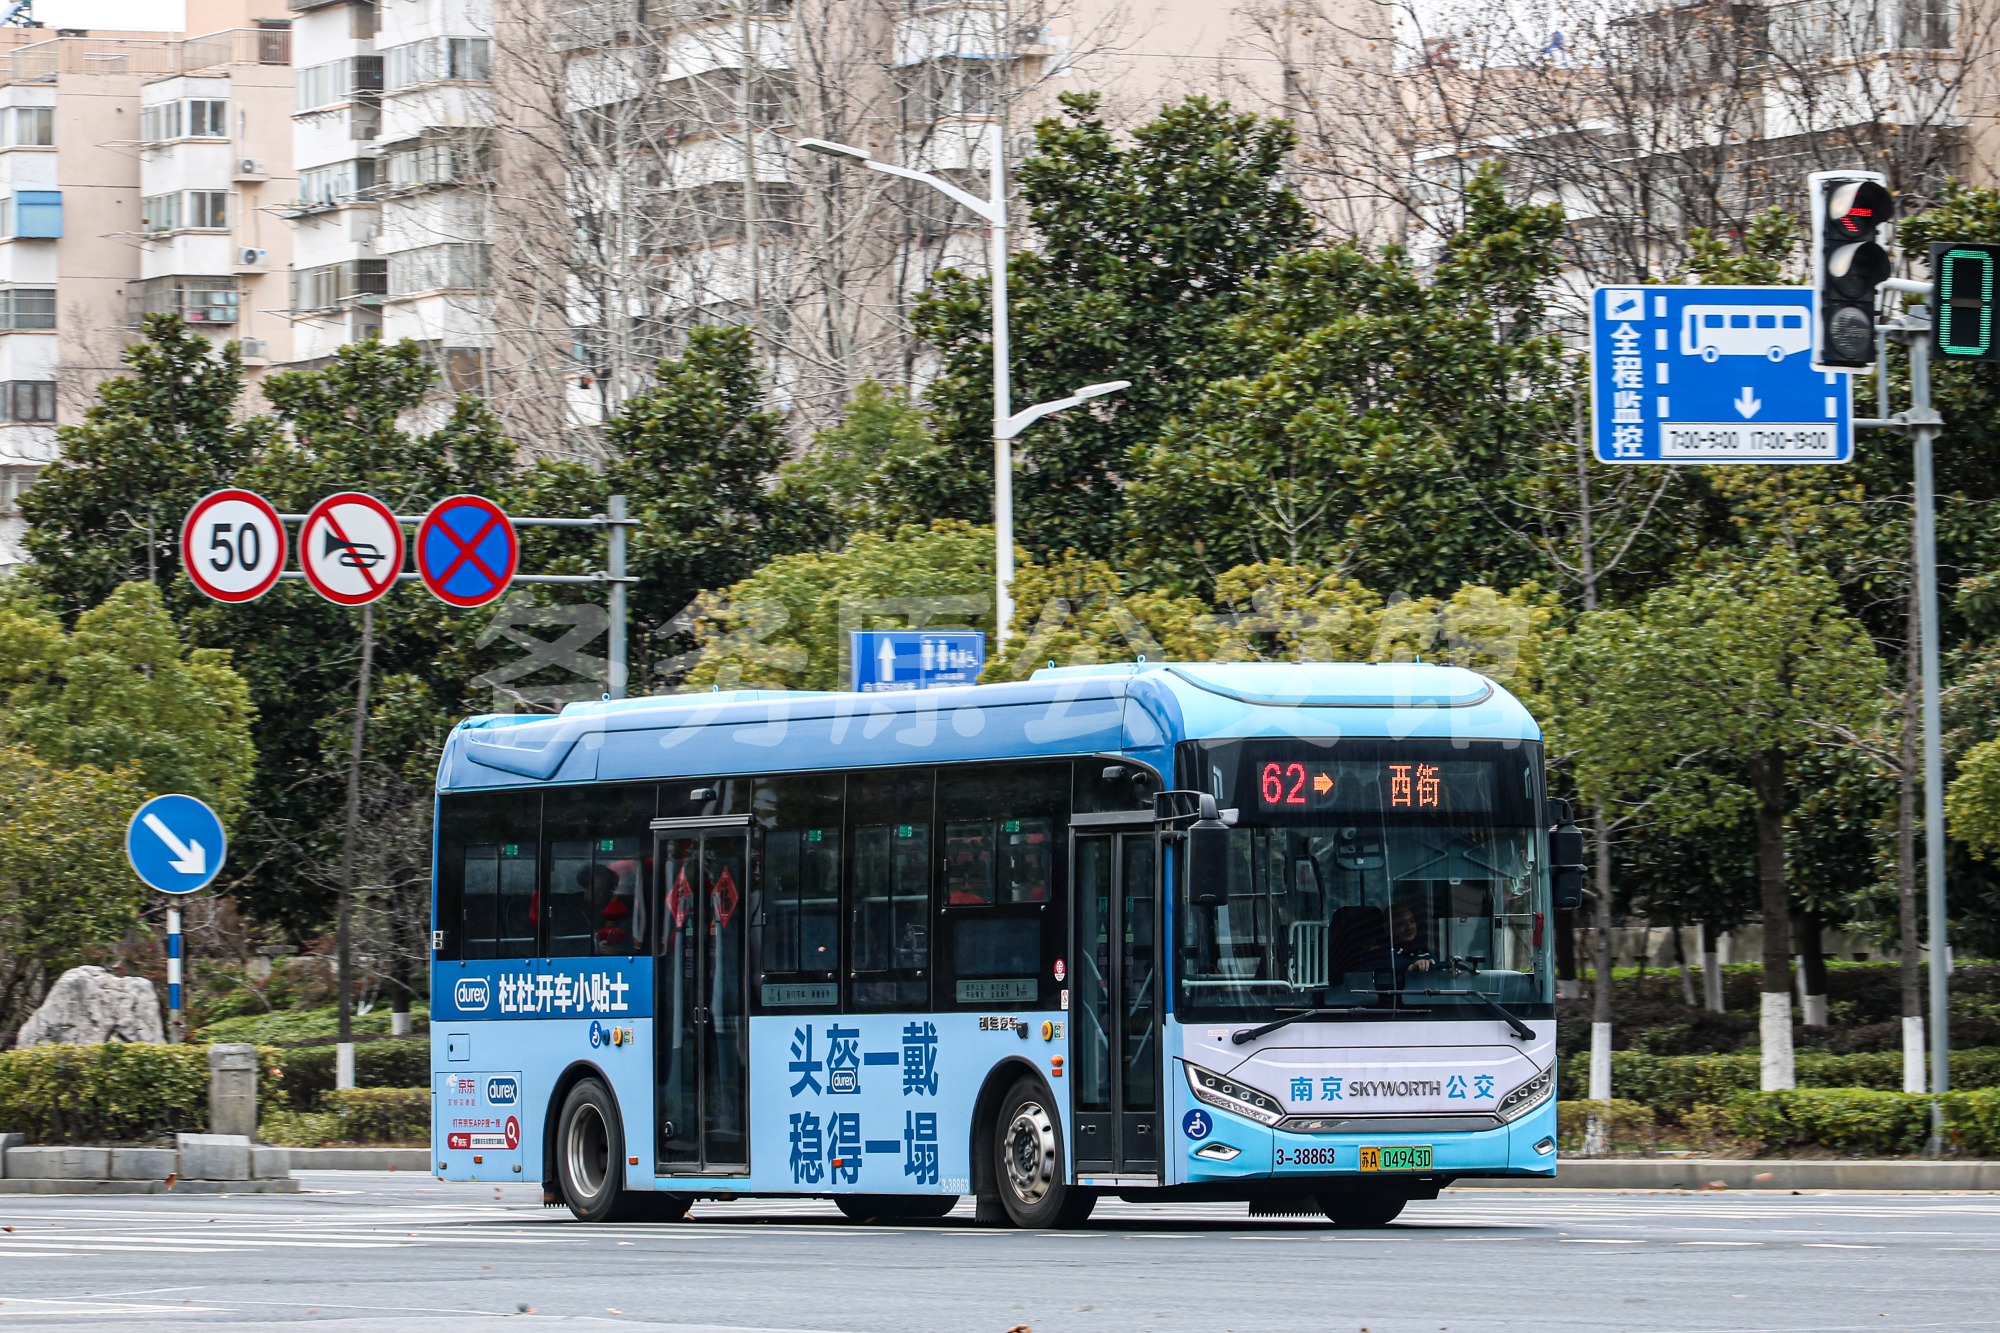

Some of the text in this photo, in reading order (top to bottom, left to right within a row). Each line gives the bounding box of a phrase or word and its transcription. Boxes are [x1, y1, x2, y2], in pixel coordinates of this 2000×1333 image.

[1610, 323, 1644, 458] 全程监控
[1669, 431, 1829, 450] 7:00-9:00 17:00-19:00
[209, 522, 261, 572] 50
[1261, 763, 1306, 805] 62
[1389, 763, 1441, 807] 西街
[458, 983, 488, 1004] durex
[498, 972, 630, 1013] 杜杜开车小贴士
[789, 1021, 939, 1098] 头盔一戴
[458, 1079, 476, 1094] 京东
[489, 1080, 518, 1102] durex
[833, 1072, 855, 1088] durex
[1290, 1074, 1495, 1102] 南京 SKYWORTH 公交
[789, 1110, 939, 1185] 稳得一塌
[1276, 1147, 1336, 1165] 3-38863
[1383, 1148, 1432, 1168] 04943D
[941, 1178, 969, 1193] 3-38863
